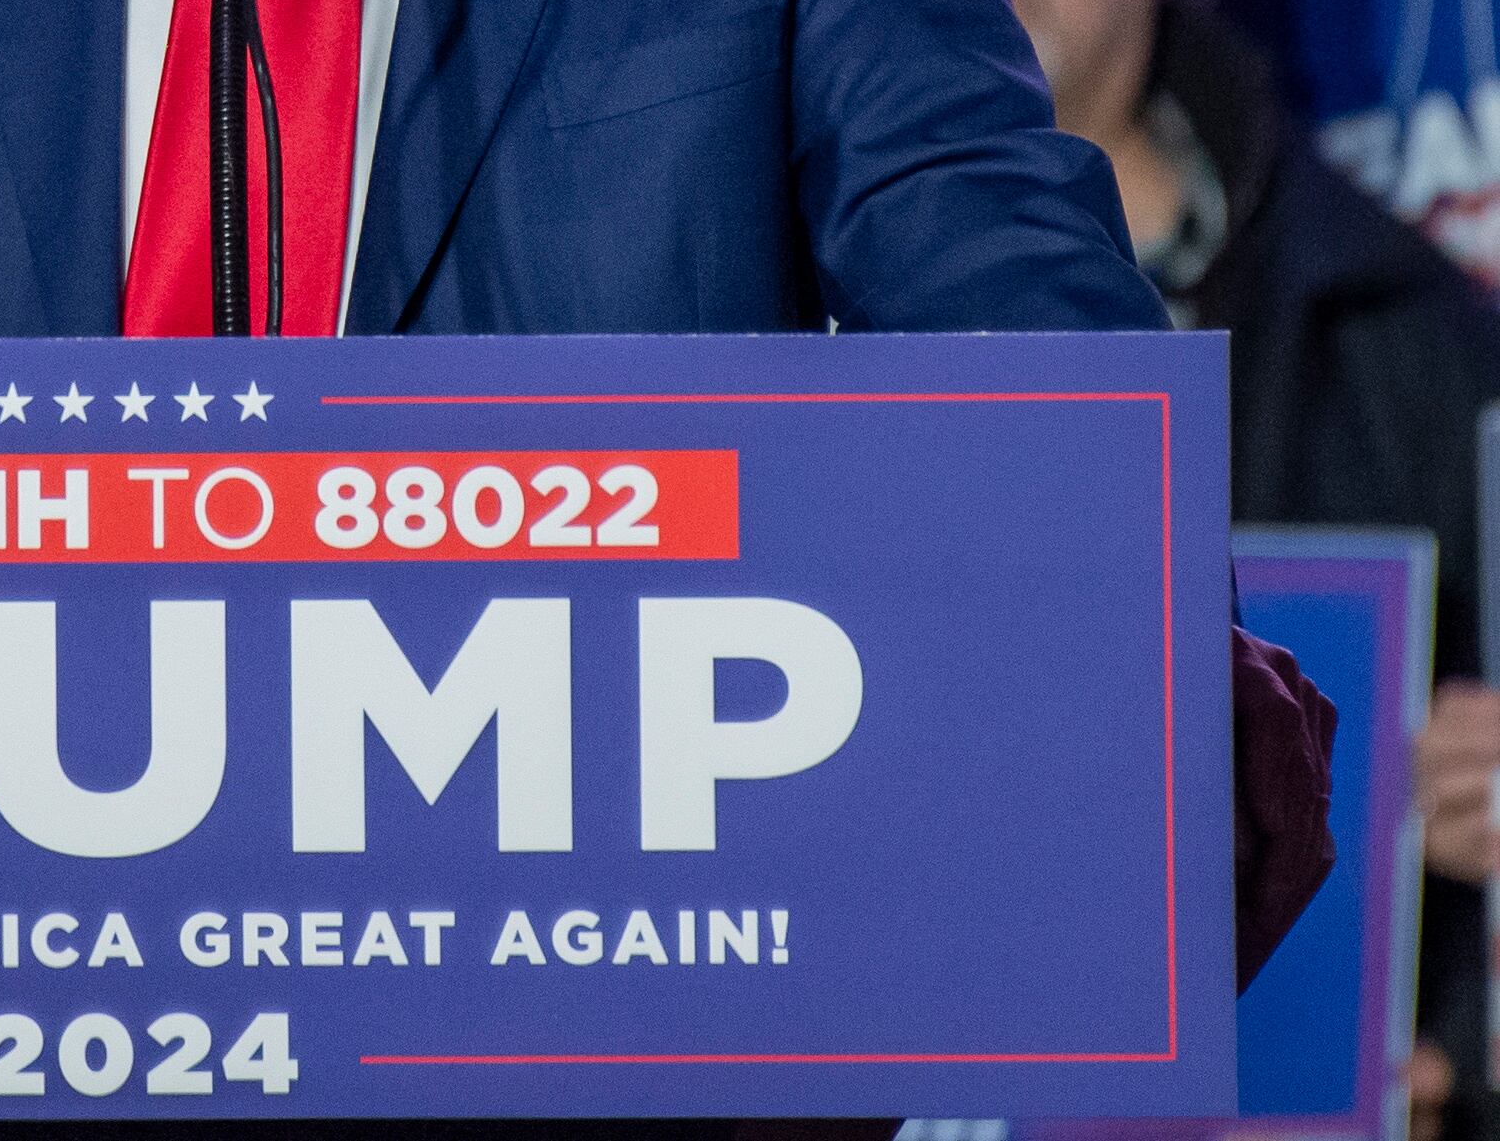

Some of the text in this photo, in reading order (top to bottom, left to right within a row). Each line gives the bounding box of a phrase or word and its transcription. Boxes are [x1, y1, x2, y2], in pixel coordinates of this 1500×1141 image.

[127, 467, 274, 549] TO
[315, 465, 659, 549] 88022
[180, 911, 455, 967] GREAT
[490, 909, 788, 965] AGAIN!
